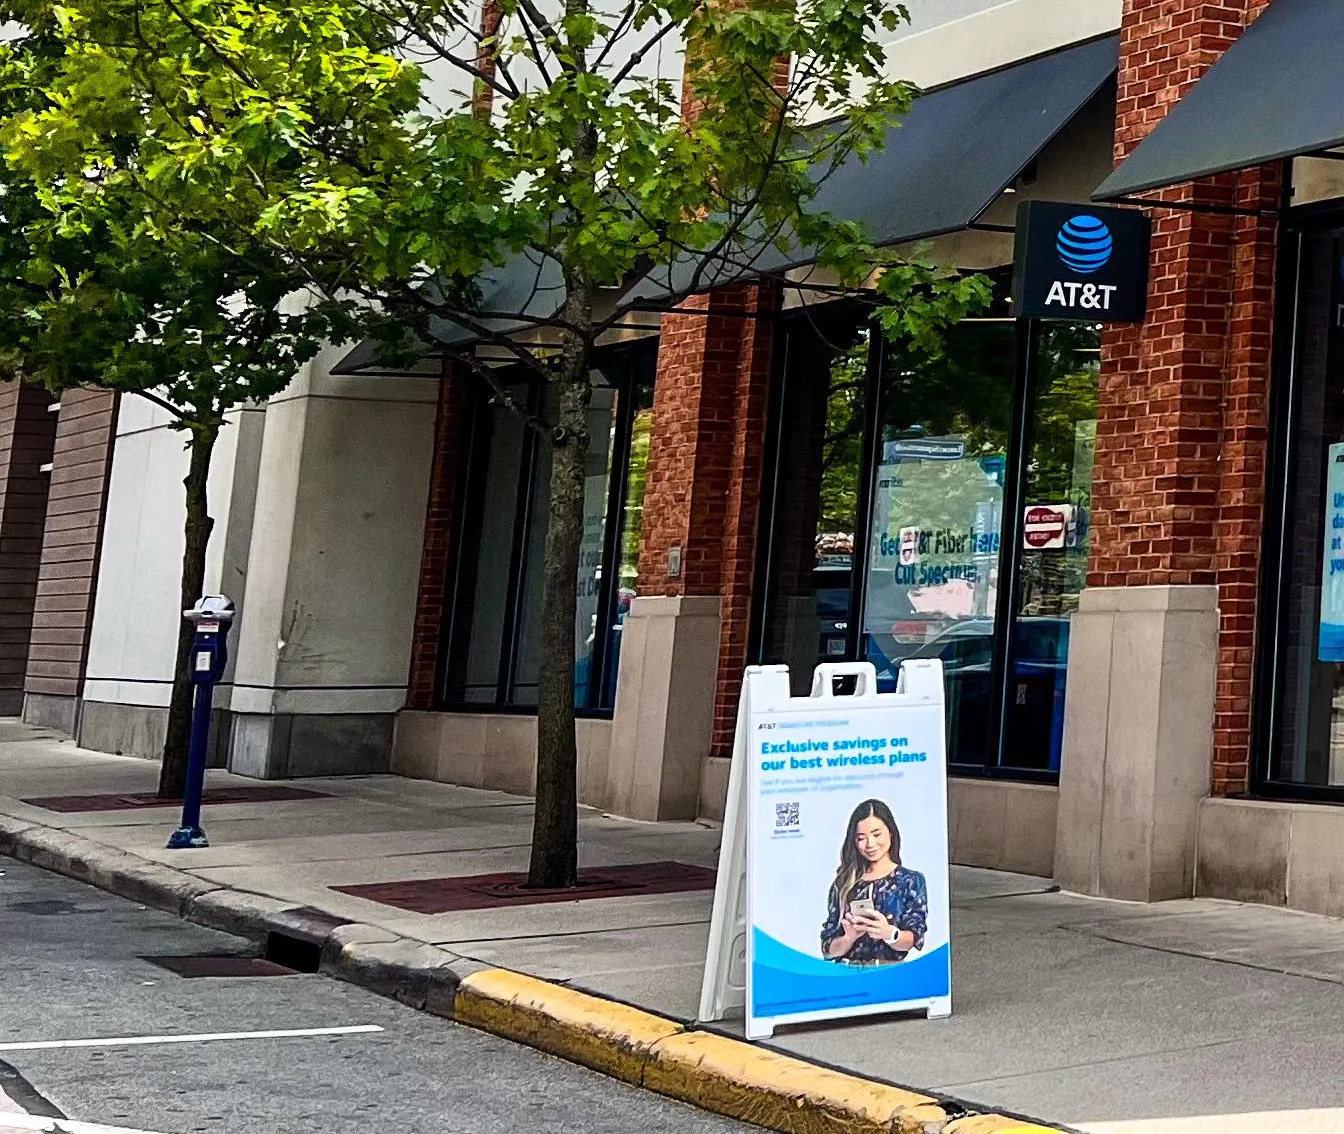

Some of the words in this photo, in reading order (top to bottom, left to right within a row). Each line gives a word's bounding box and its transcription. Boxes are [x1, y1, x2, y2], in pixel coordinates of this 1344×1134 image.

[1045, 281, 1117, 309] AT&T
[934, 528, 968, 555] Fiber
[1331, 537, 1341, 550] at
[895, 562, 917, 585] Cut
[758, 723, 776, 731] AT&T
[761, 739, 829, 755] Exclusive
[833, 735, 887, 752] savings
[890, 737, 908, 748] on
[761, 759, 786, 771] our
[790, 756, 823, 769] best
[827, 753, 885, 767] wireless
[889, 750, 927, 767] plans
